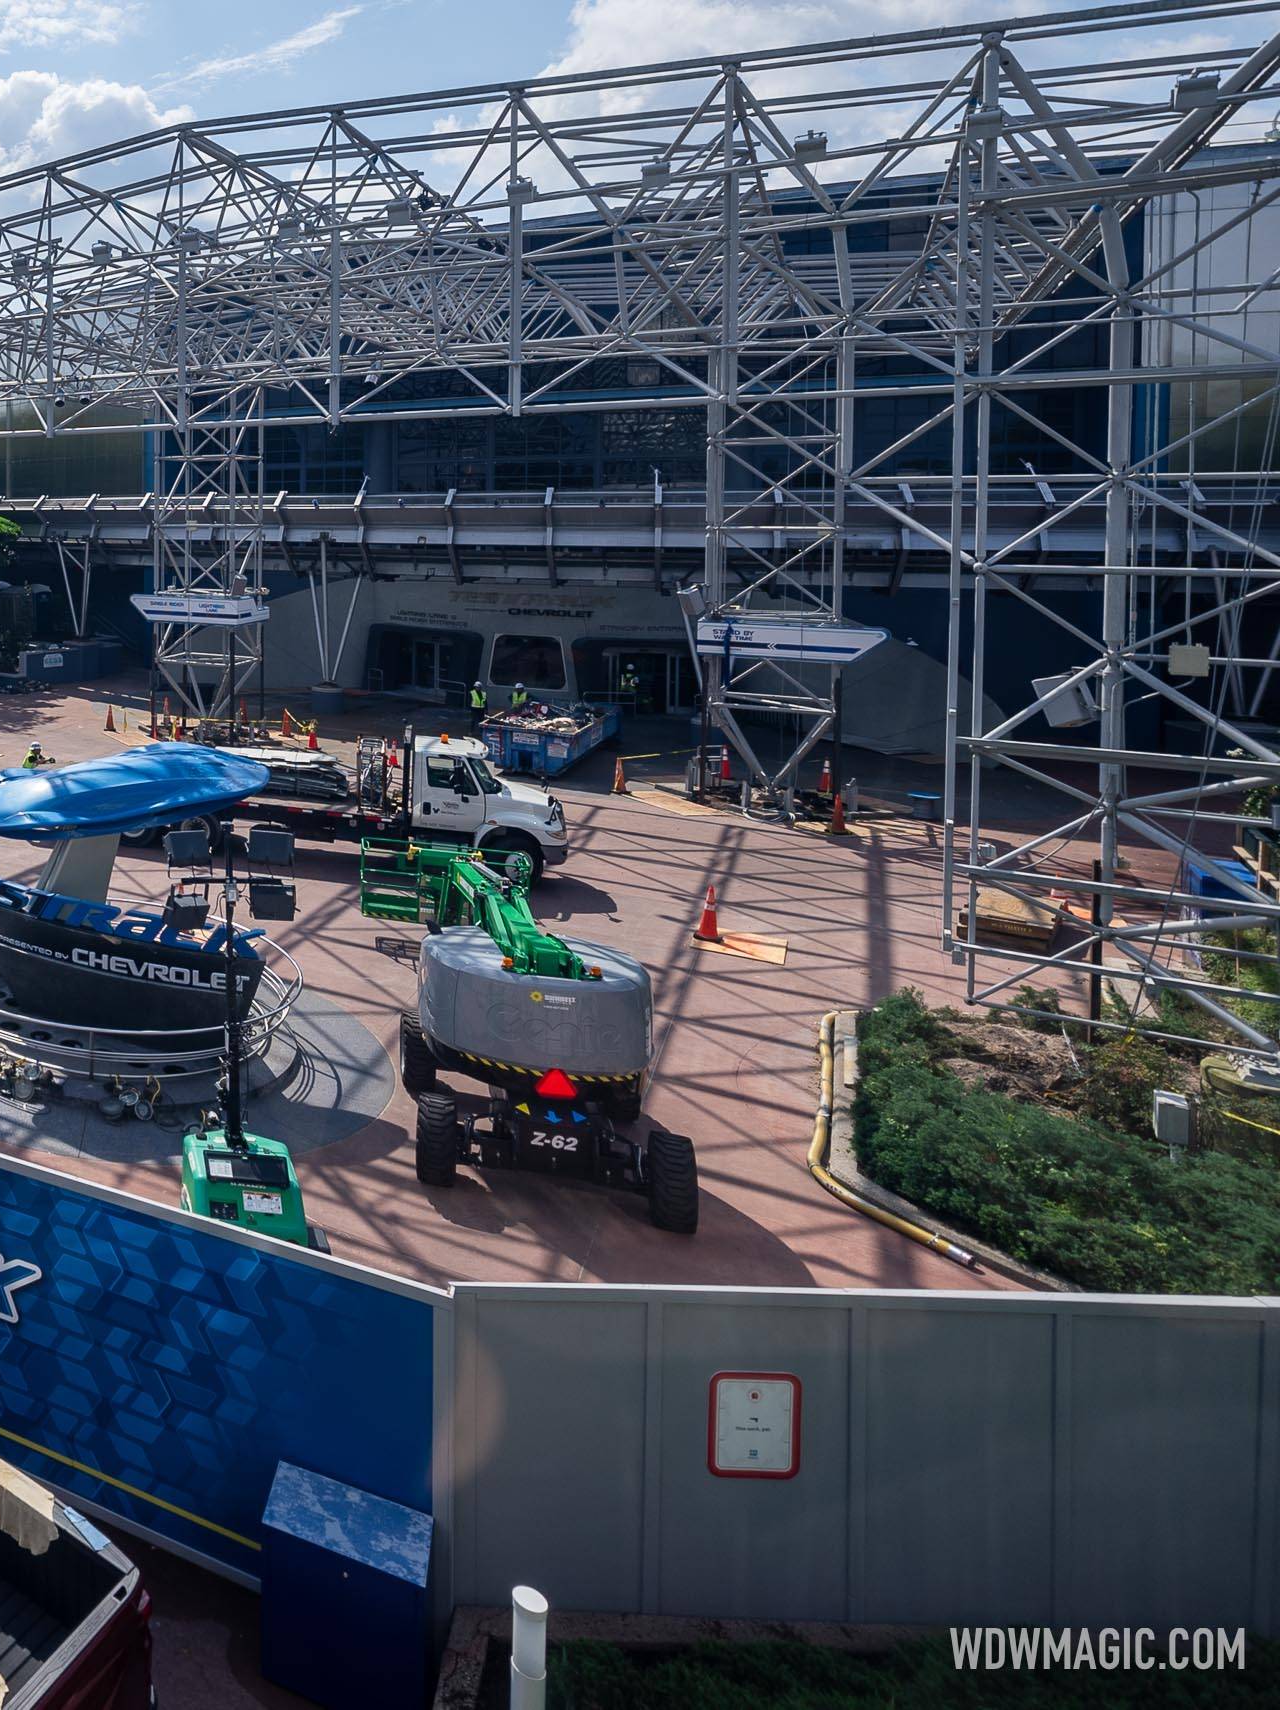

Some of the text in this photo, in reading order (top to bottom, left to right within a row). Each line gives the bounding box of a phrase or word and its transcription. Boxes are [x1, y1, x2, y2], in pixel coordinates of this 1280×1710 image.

[508, 608, 594, 618] CHEVROLET
[54, 951, 69, 960] BY
[72, 948, 250, 992] CHEVROLET
[530, 1131, 578, 1152] Z-62
